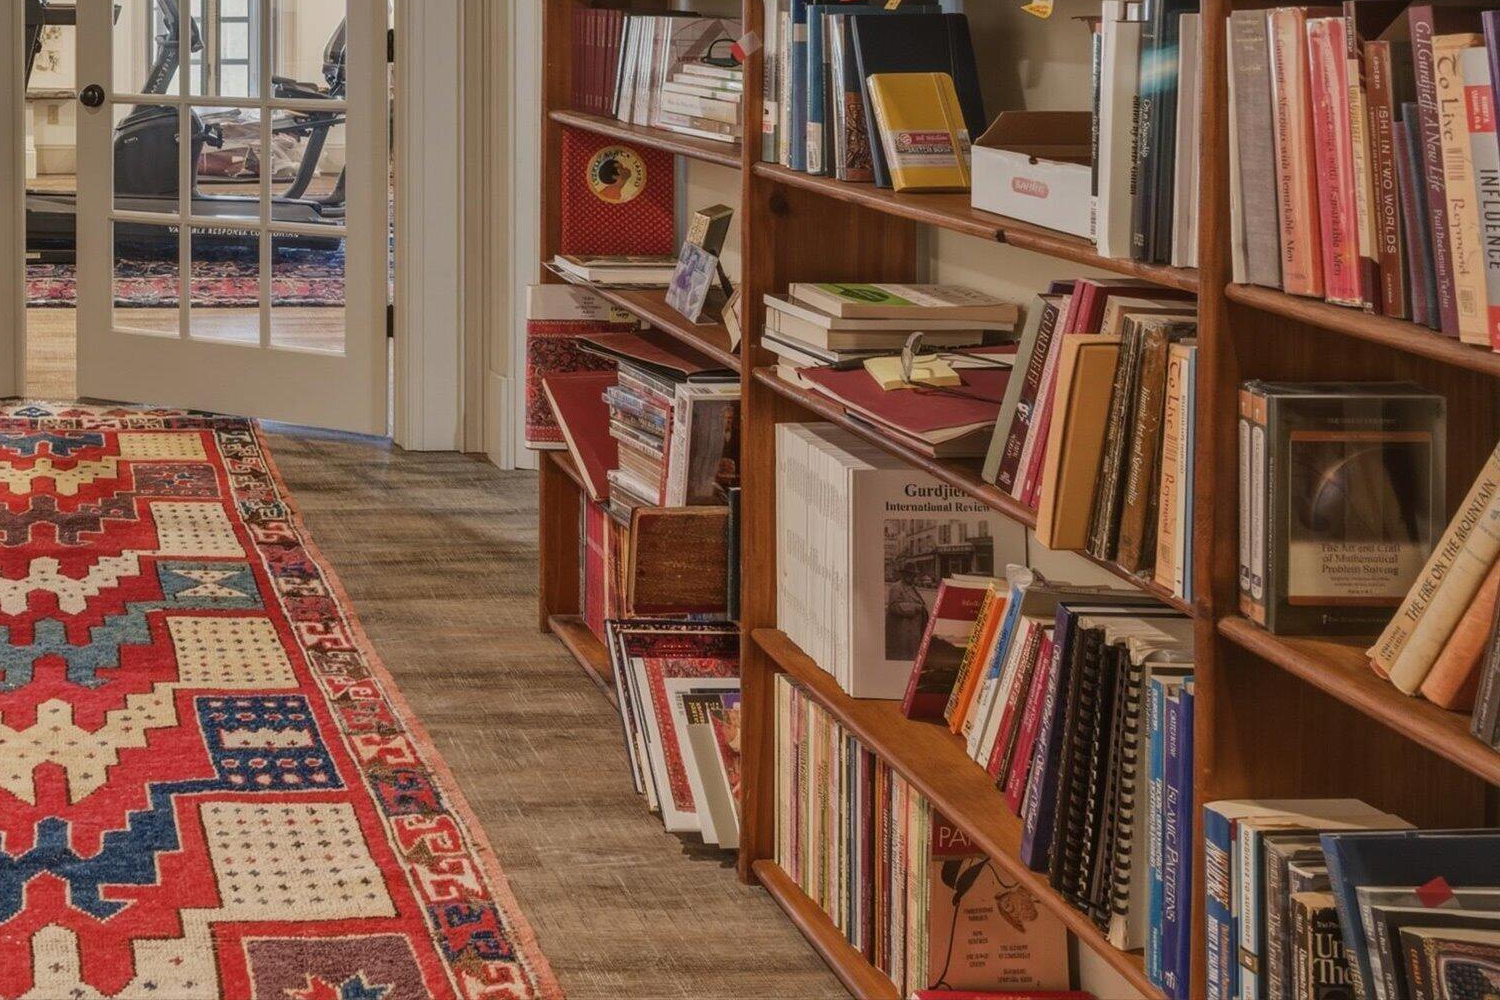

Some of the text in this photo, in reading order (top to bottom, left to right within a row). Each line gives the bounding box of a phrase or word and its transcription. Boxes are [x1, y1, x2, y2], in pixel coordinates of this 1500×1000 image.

[1412, 19, 1444, 193] G.I. Gurdjieff: A New Life
[1435, 54, 1463, 142] To Live
[1377, 105, 1388, 134] ISHI
[1280, 144, 1291, 169] with
[1380, 139, 1390, 154] IN
[1381, 159, 1392, 190] TWO
[1281, 174, 1294, 234] Remarkable
[1327, 185, 1344, 248] Remarkable
[1432, 208, 1444, 230] Paul
[1480, 169, 1500, 270] INFLUENCE
[1382, 194, 1397, 254] WORLDS
[1332, 252, 1345, 277] Men
[1028, 308, 1059, 388] GURDJIEFF
[1169, 361, 1180, 388] To
[1136, 419, 1146, 436] Art
[1167, 388, 1180, 432] Live
[1133, 435, 1144, 455] and
[1126, 453, 1141, 508] Spirituality
[885, 501, 990, 513] International Review
[1322, 554, 1398, 564] of Mathematical
[1403, 477, 1497, 622] THE FIRE ON THE MOUNTAIN
[1322, 564, 1399, 576] Problem Solving
[1166, 784, 1178, 844] ISLAMIC
[1164, 846, 1177, 923] PATTERNS
[1244, 881, 1250, 892] TO
[1267, 912, 1282, 969] The True
